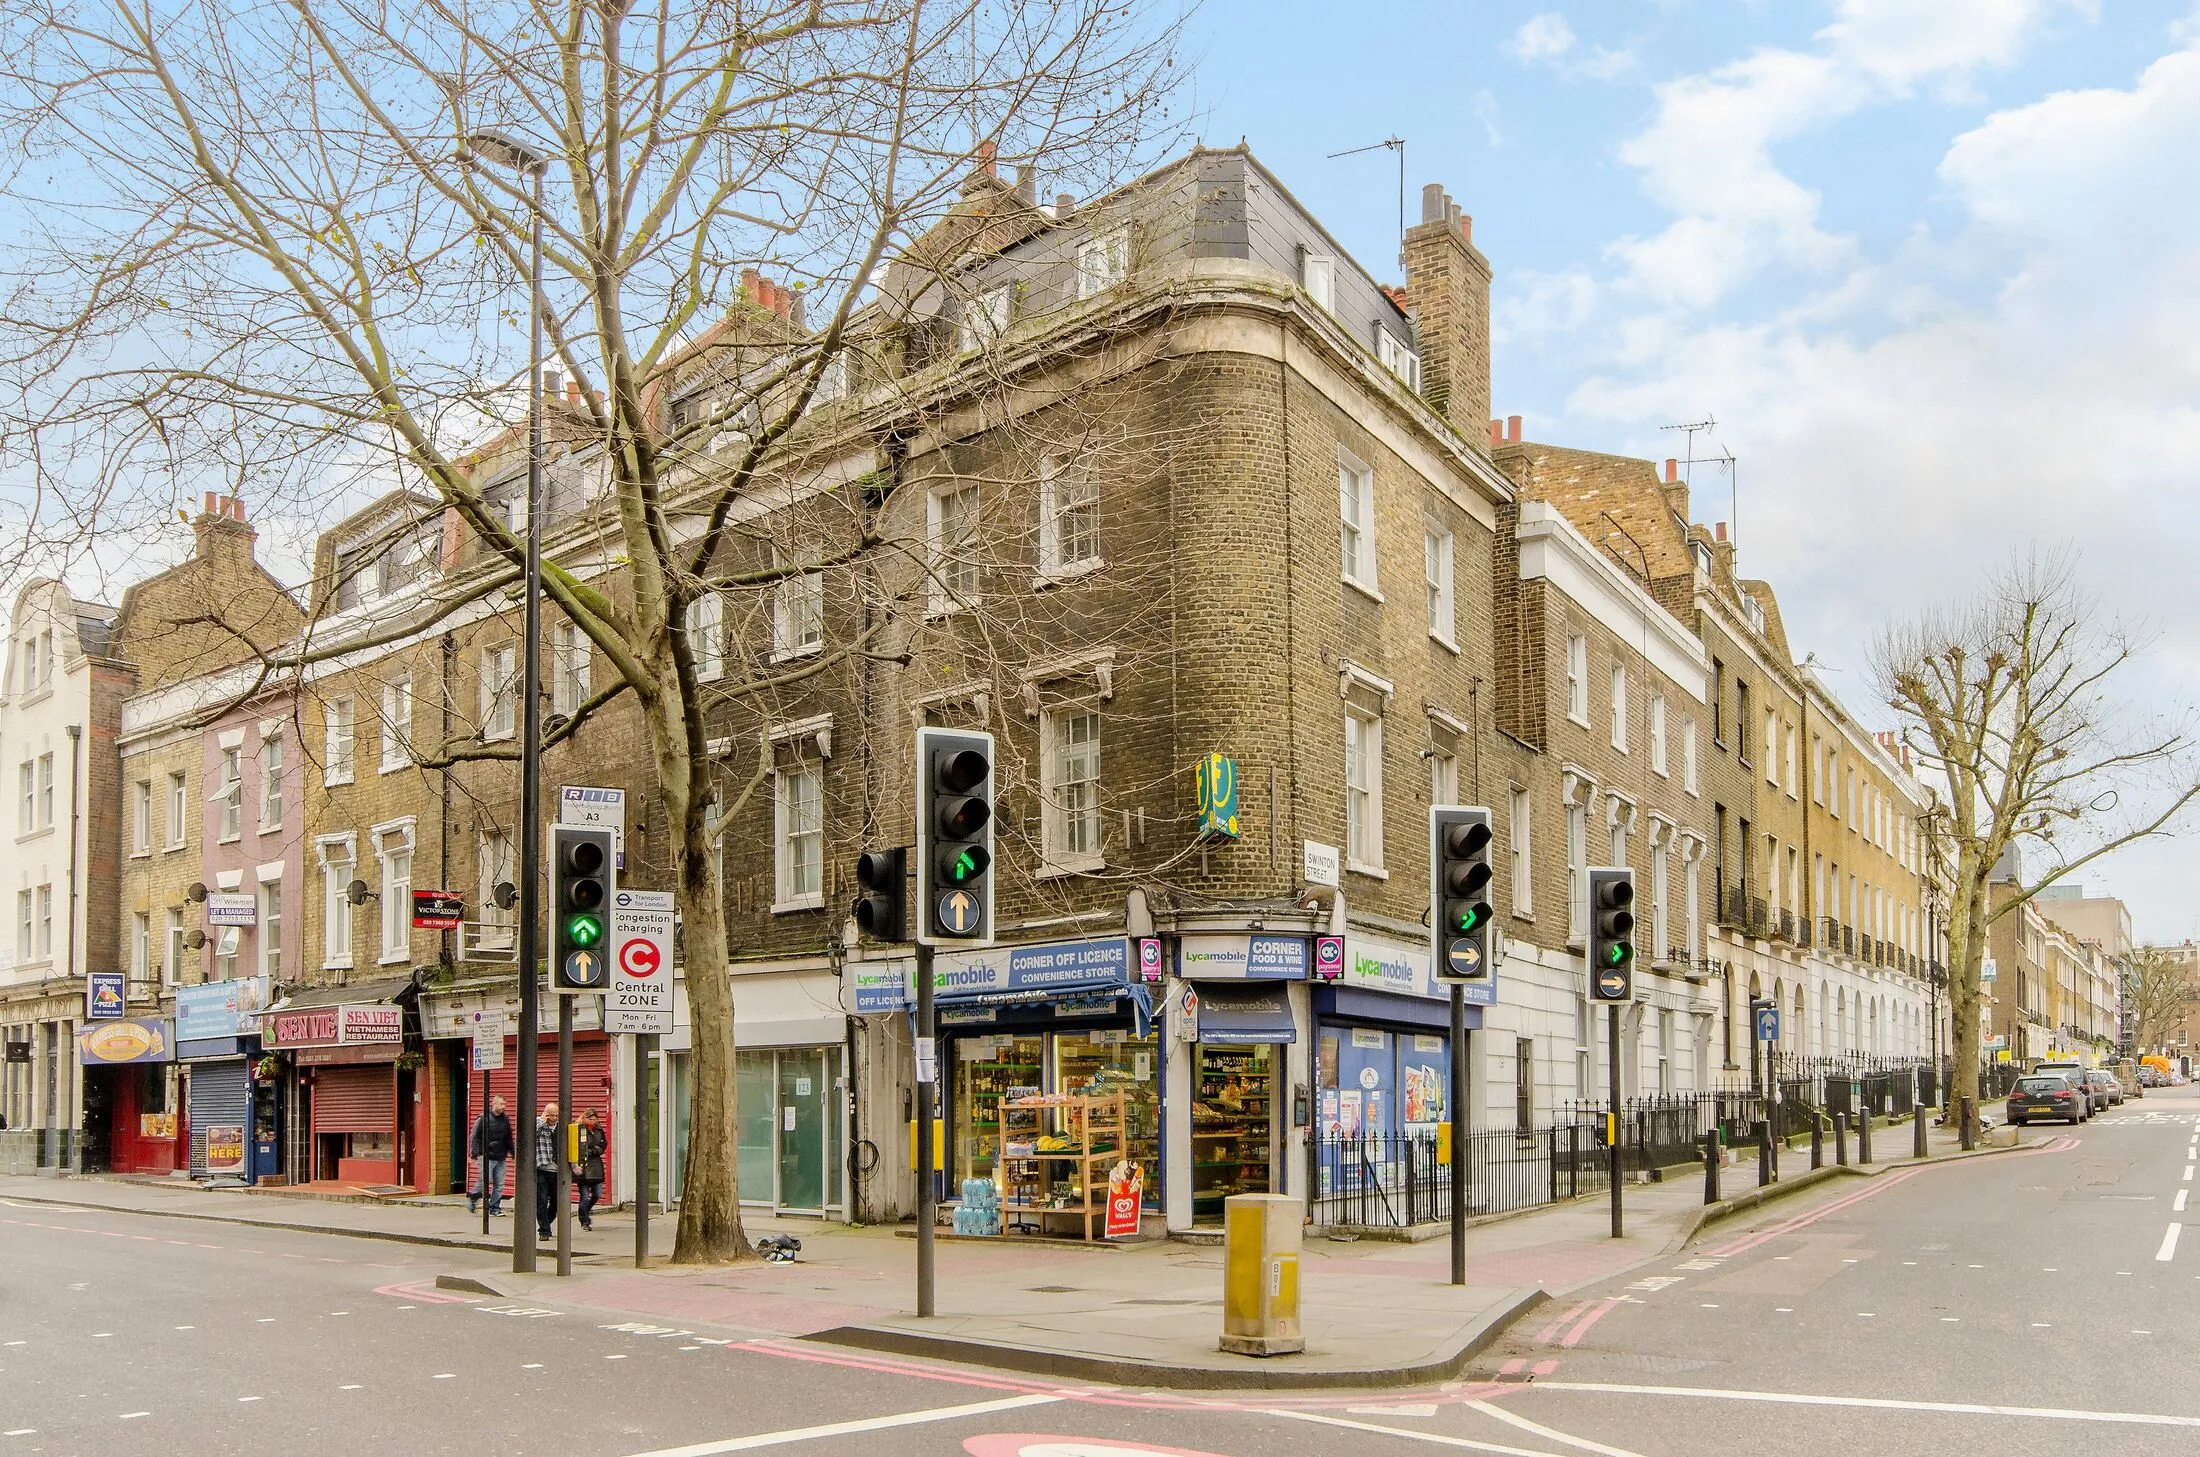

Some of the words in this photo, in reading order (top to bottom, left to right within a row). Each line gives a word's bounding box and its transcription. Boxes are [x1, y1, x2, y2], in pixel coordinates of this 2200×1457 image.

[586, 812, 600, 821] A3
[1308, 853, 1335, 869] SWINTON
[1306, 866, 1328, 880] STREET
[617, 924, 663, 934] charging
[1253, 942, 1302, 954] CORNER
[1013, 955, 1054, 970] CORNER
[1056, 952, 1076, 966] OFF
[1078, 948, 1122, 964] LICENCE
[1186, 951, 1246, 962] Lycamobile
[1252, 955, 1276, 964] FOOD
[1278, 956, 1283, 964] &
[1285, 956, 1302, 964] WINE
[1355, 952, 1412, 982] Lycamobile
[858, 973, 904, 986] Lycamobil
[912, 965, 996, 988] Lamobile
[1022, 970, 1083, 983] CONVENIENCE
[1086, 966, 1116, 978] STORE
[616, 982, 664, 992] Central
[1438, 983, 1473, 998] CONNCE
[1474, 989, 1490, 1000] STORE
[619, 995, 658, 1006] ZONE
[860, 997, 875, 1006] OFF
[877, 995, 904, 1005] LICENC
[1205, 1000, 1281, 1012] Lycamobile
[347, 1011, 370, 1024] SEN
[372, 1012, 398, 1024] VIET
[279, 1016, 309, 1040] SEN
[311, 1013, 339, 1040] VIE
[1355, 1032, 1380, 1044] Lycamobile
[209, 1149, 241, 1158] HERE
